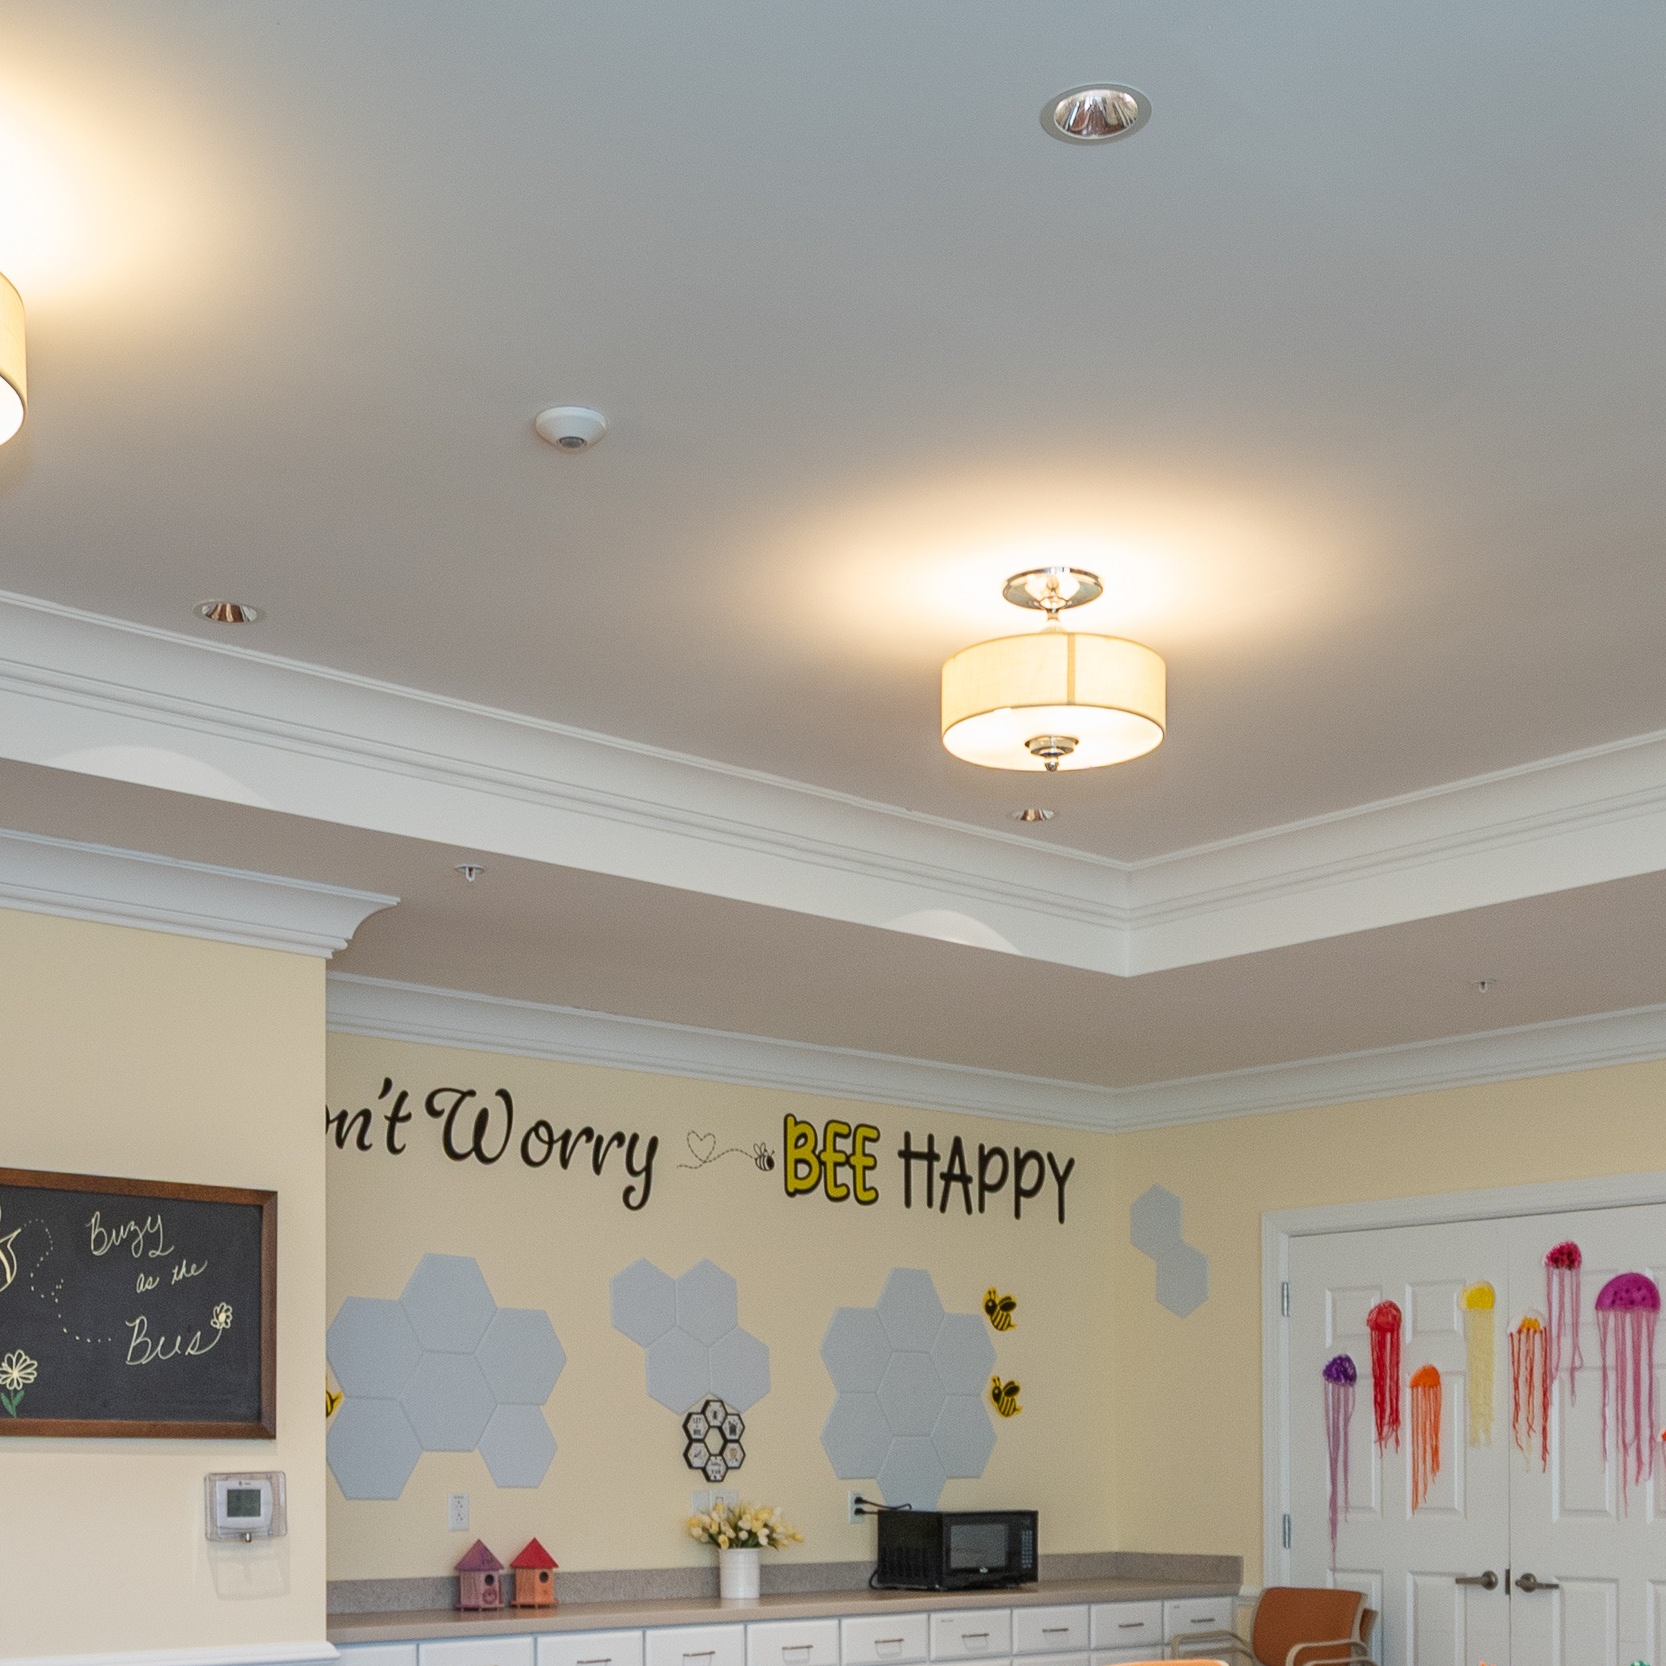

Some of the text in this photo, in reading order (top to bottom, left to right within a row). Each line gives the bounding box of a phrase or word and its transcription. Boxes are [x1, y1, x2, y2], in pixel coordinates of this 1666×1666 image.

[326, 1077, 1075, 1224] n't Worry BEE HAPPY
[85, 1211, 174, 1257] Buzy
[136, 1259, 208, 1293] as the
